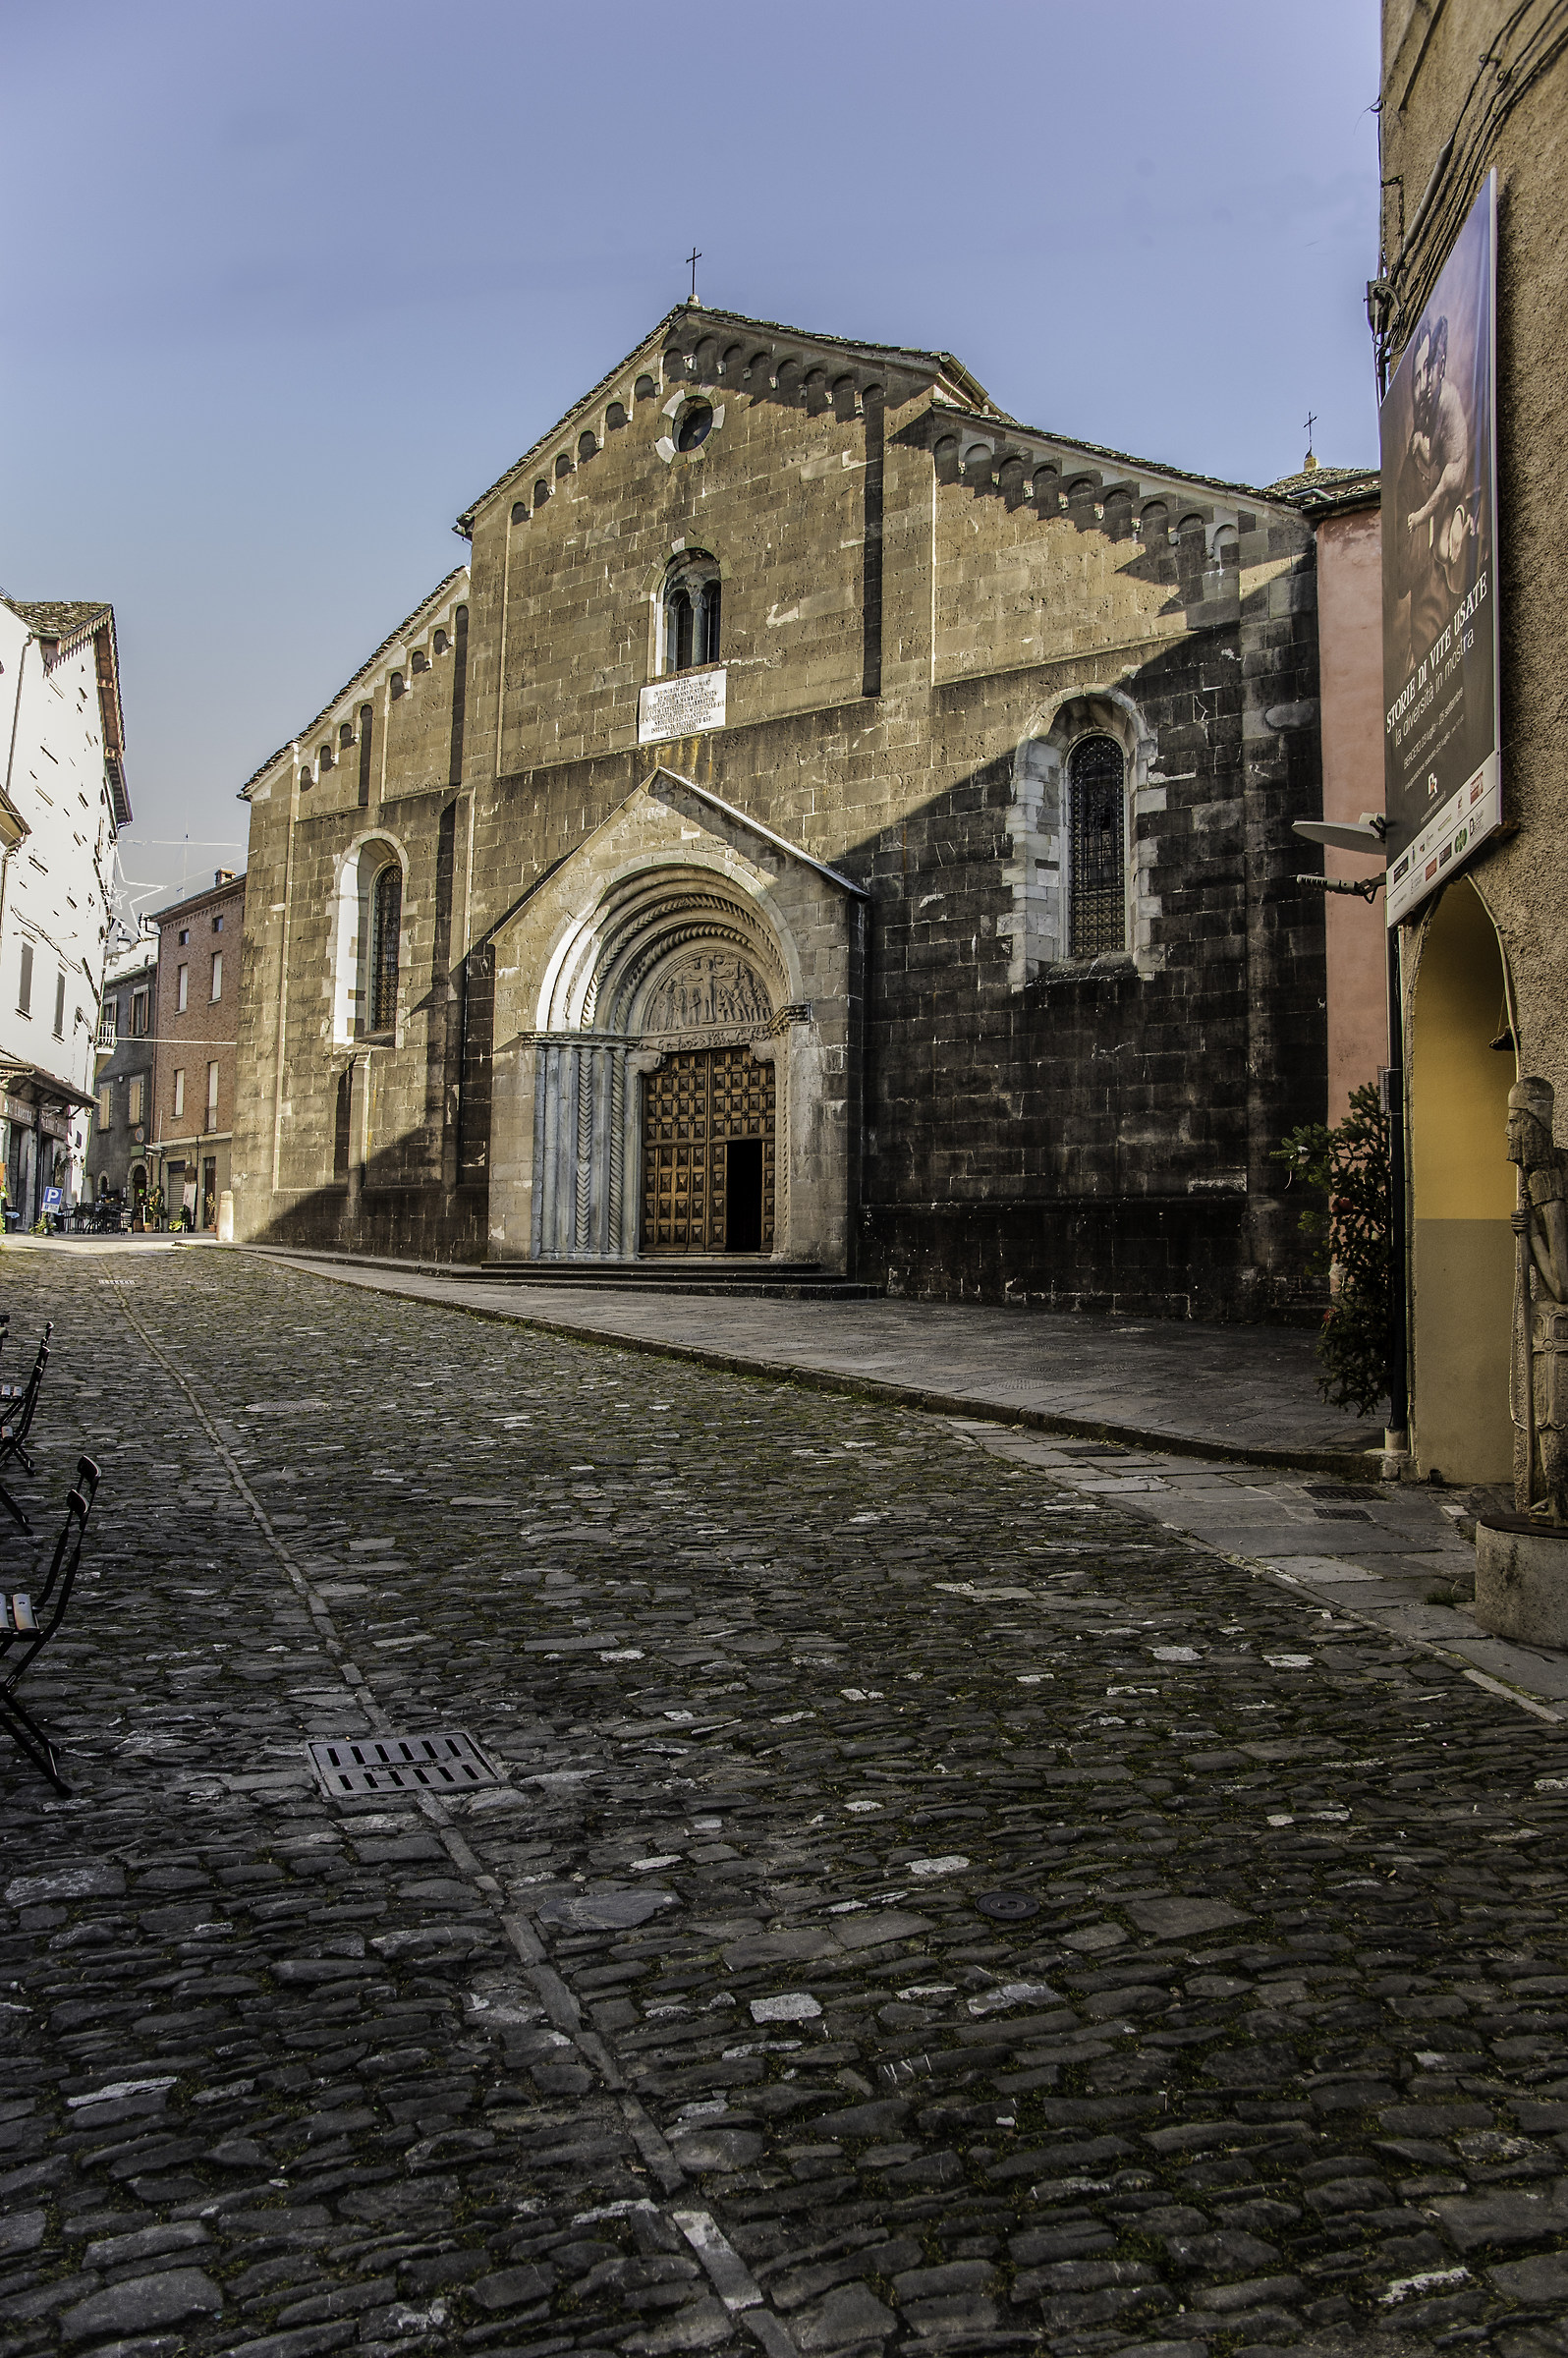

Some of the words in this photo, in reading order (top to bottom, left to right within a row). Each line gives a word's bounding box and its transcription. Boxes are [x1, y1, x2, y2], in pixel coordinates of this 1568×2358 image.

[1386, 677, 1416, 734] STORIE
[1418, 659, 1428, 691] DI
[1429, 624, 1452, 671] VITE
[1454, 571, 1488, 637] USATE
[1395, 727, 1402, 748] la
[1403, 682, 1434, 737] diversità
[1435, 671, 1443, 694] in
[1444, 628, 1475, 681] mostra
[47, 1189, 59, 1202] P
